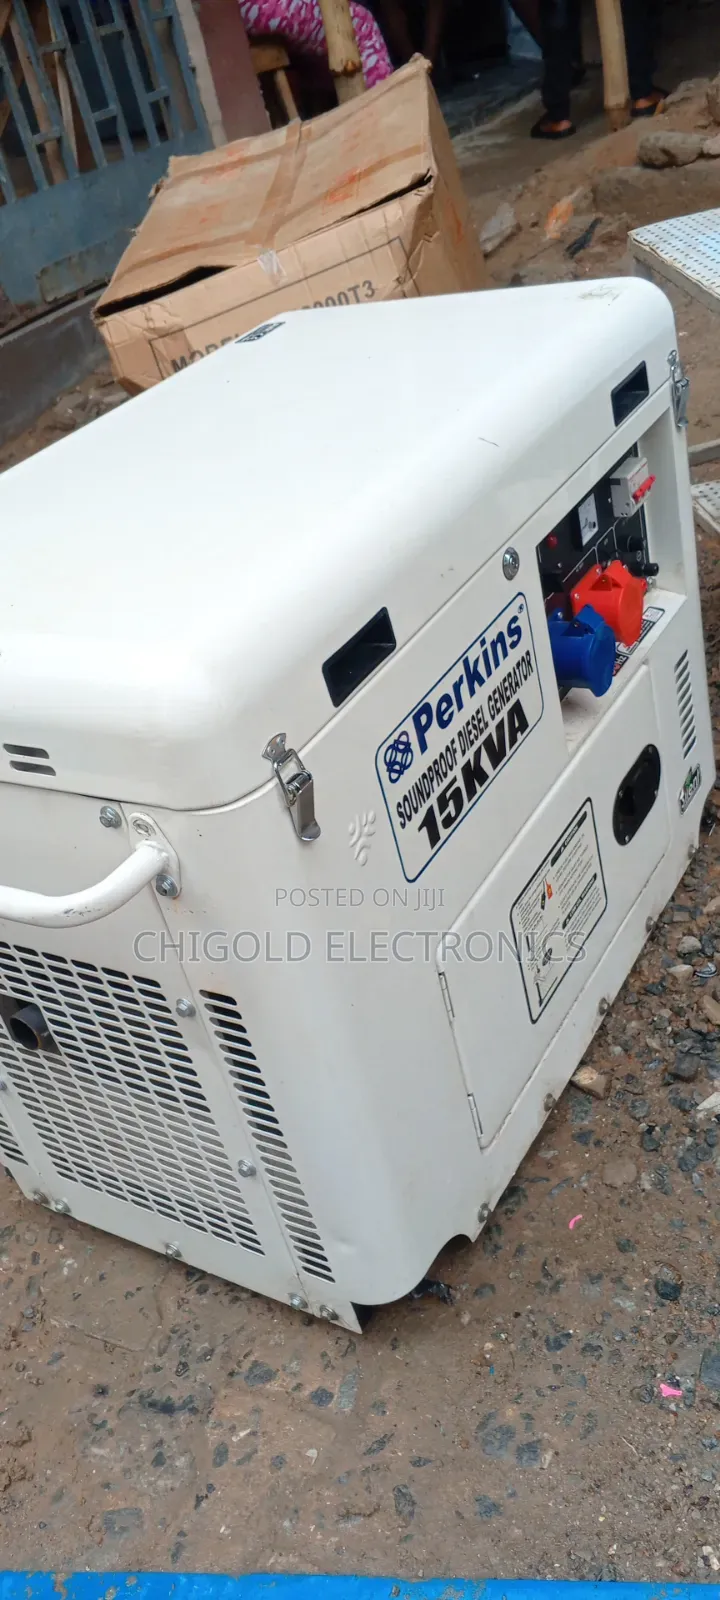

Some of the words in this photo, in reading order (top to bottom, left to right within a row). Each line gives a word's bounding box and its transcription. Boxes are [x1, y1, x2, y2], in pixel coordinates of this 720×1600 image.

[396, 738, 458, 829] SOUNDPROOF
[456, 705, 489, 757] DIESEL
[487, 650, 534, 722] GENERATOR
[412, 614, 522, 755] Perkins
[417, 698, 530, 850] 15KVA
